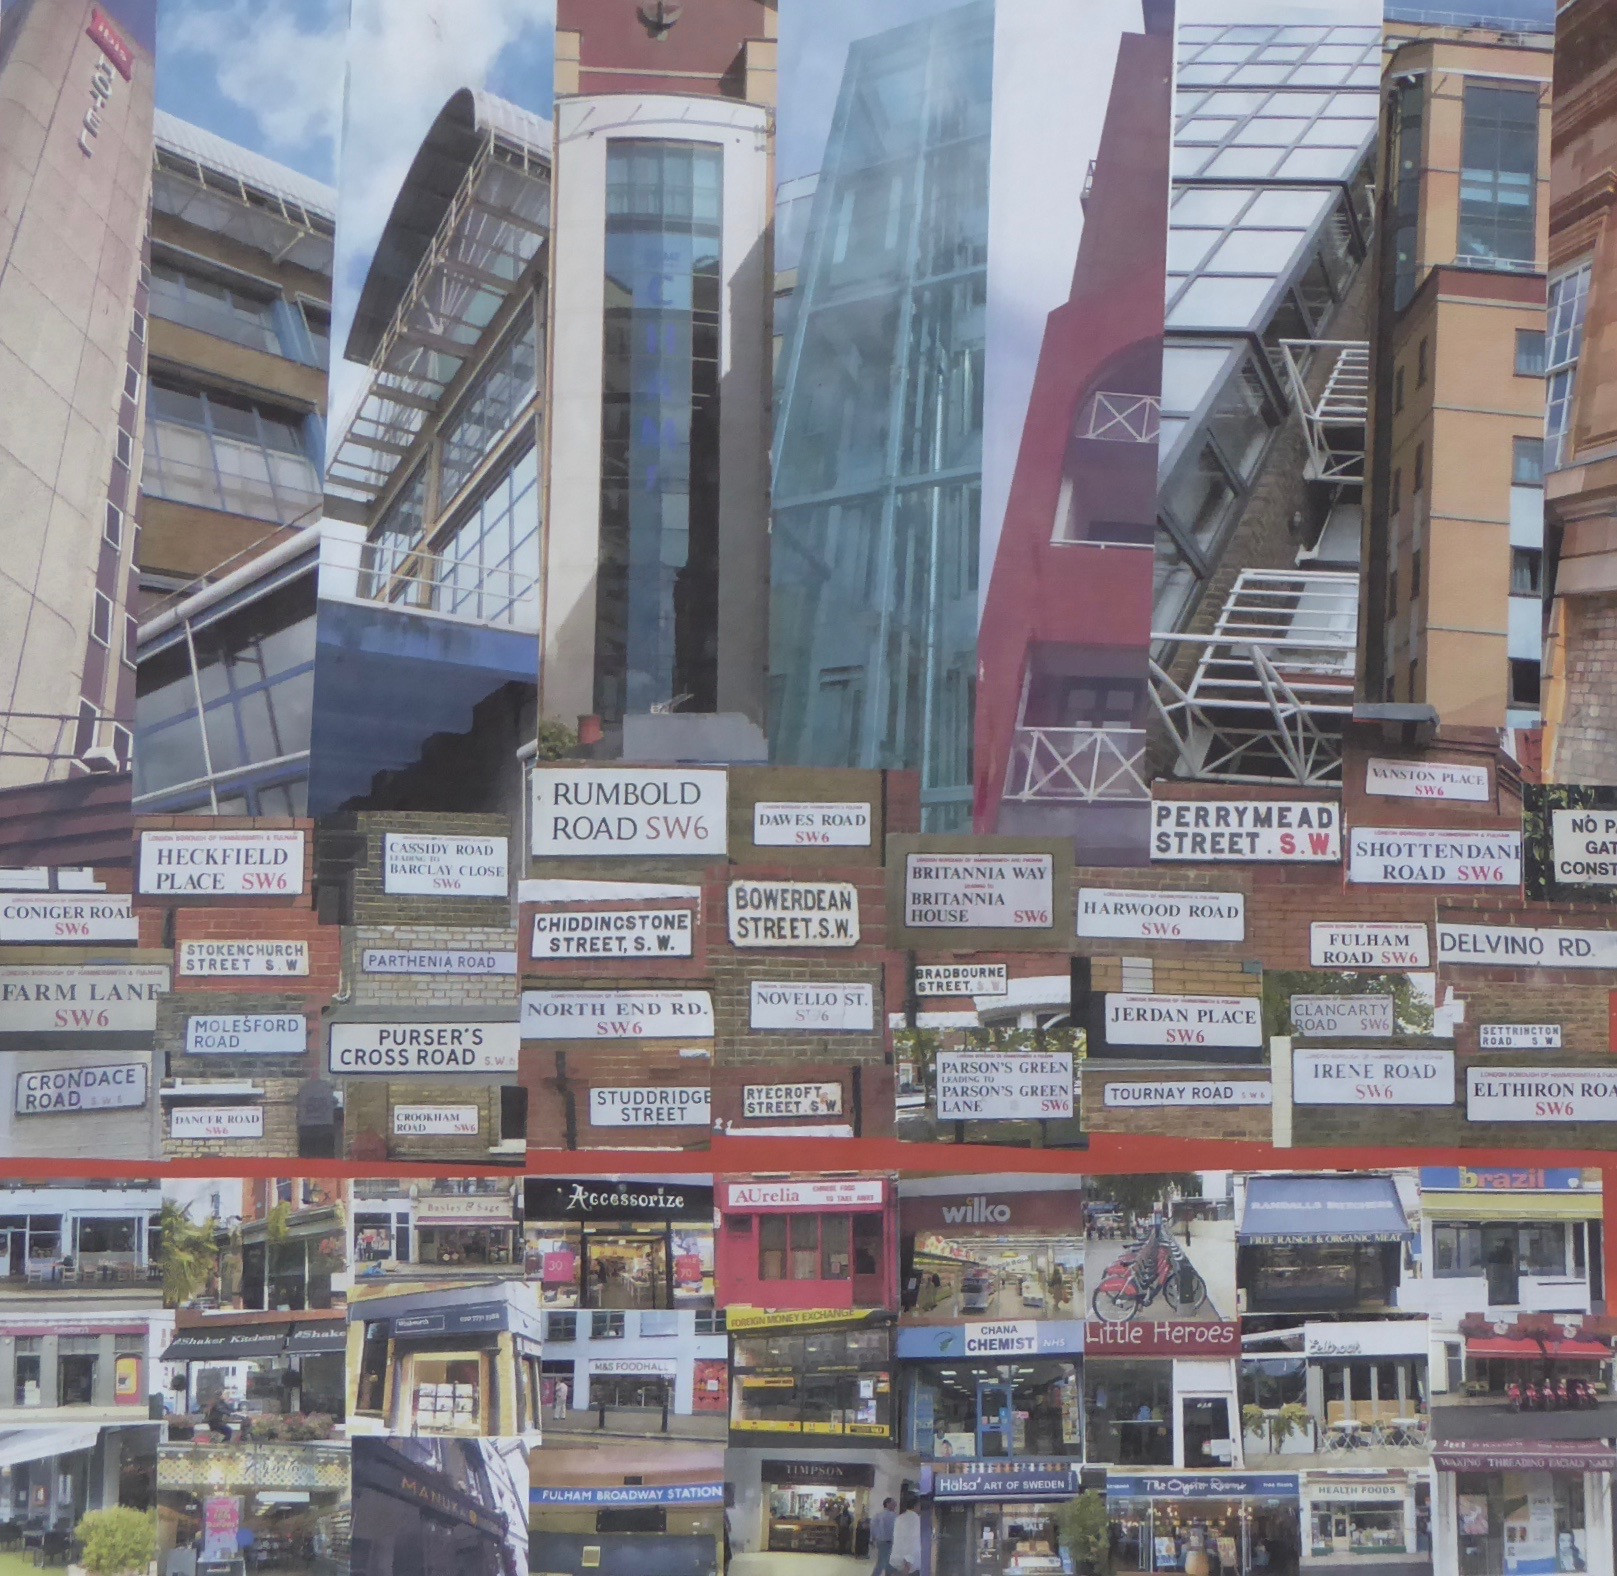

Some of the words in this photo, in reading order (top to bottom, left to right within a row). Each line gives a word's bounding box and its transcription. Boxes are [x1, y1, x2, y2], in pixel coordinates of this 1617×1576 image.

[1373, 768, 1435, 781] VANSTON
[1442, 772, 1485, 786] PLACE
[553, 782, 700, 806] RUMBOLD
[1415, 786, 1444, 796] SW6
[760, 814, 814, 826] DAWES
[822, 814, 866, 827] ROAD
[1156, 806, 1333, 828] PERRYMEAD
[552, 816, 638, 840] ROAD
[645, 816, 709, 840] SW6
[1572, 818, 1598, 834] NO
[1605, 819, 1617, 834] P
[795, 831, 830, 844] SW6
[390, 842, 449, 855] CASSIDY
[456, 844, 494, 856] ROAD
[156, 848, 288, 866] HECKFIELD
[390, 864, 452, 876] BARCLAY
[458, 866, 505, 878] CLOSE
[912, 866, 1006, 880] BRITANNIA
[1012, 866, 1047, 880] WAY
[1383, 864, 1446, 881] ROAD
[1458, 866, 1504, 882] SW6
[156, 872, 226, 890] PLACE
[242, 872, 288, 890] SW6
[432, 878, 461, 889] SW6
[736, 886, 852, 912] BOWERDEAN
[911, 892, 1006, 906] BRITANNIA
[4, 906, 85, 919] CONIGER
[911, 909, 969, 923] HOUSE
[1014, 910, 1048, 924] SW6
[1084, 902, 1181, 918] HARWOOD
[1189, 904, 1239, 920] ROAD
[55, 922, 90, 936] SW6
[1141, 922, 1182, 936] SW6
[1330, 934, 1410, 947] FULHAM
[1440, 932, 1544, 955] DELVINO
[186, 943, 304, 958] STOKENCHURCH
[186, 958, 251, 972] STREET
[368, 956, 453, 968] PARTHENIA
[458, 956, 496, 968] ROAD
[1323, 952, 1374, 964] ROAD
[1382, 952, 1418, 964] SW6
[916, 967, 1004, 980] BRADBOURNE
[2, 983, 77, 1001] FARM
[757, 992, 838, 1006] NOVELLO
[844, 993, 868, 1006] ST.
[528, 1002, 606, 1017] NORTH
[616, 1002, 662, 1017] END
[671, 1002, 708, 1017] RD.
[796, 1008, 830, 1022] S6
[1112, 1006, 1188, 1023] JERDAN
[1198, 1008, 1257, 1024] PLACE
[1294, 1004, 1390, 1016] CLANCARTY
[54, 1008, 110, 1028] SW6
[1295, 1018, 1338, 1030] ROAD
[1360, 1018, 1390, 1030] SW6
[194, 1018, 298, 1034] MOLESFORD
[596, 1020, 643, 1036] SW6
[194, 1035, 240, 1048] ROAD
[379, 1028, 484, 1046] PURSER'S
[1166, 1028, 1205, 1044] SW6
[340, 1048, 410, 1066] CROSS
[416, 1048, 476, 1066] ROAD
[941, 1061, 1014, 1074] PARSON'S
[1018, 1062, 1069, 1074] GREEN
[1314, 1064, 1374, 1080] IRENE
[1384, 1063, 1437, 1080] ROAD
[26, 1068, 136, 1091] CRONDACE
[942, 1075, 980, 1084] LEADING
[984, 1075, 995, 1084] TO
[746, 1086, 822, 1100] RYECROFT
[942, 1084, 1014, 1098] PARSON'S
[1018, 1084, 1070, 1097] GREEN
[1110, 1087, 1185, 1100] TOURNAY
[1192, 1086, 1234, 1100] ROAD
[1355, 1084, 1393, 1100] SW6
[1474, 1082, 1574, 1098] ELTHIRON
[25, 1090, 80, 1110] ROAD
[597, 1090, 711, 1105] STUDDRIDGE
[942, 1100, 983, 1113] LANE
[1041, 1100, 1070, 1112] SW6
[1536, 1102, 1574, 1116] SW6
[176, 1115, 222, 1125] DANCER
[228, 1114, 260, 1124] ROAD
[396, 1113, 460, 1122] CROOKHAM
[622, 1107, 688, 1122] STREET
[206, 1126, 229, 1134] SW6
[396, 1123, 426, 1132] ROAD
[454, 1124, 476, 1132] SW6
[1460, 1166, 1546, 1190] brazil
[566, 1184, 685, 1212] Accessorize
[942, 1196, 1011, 1225] wilko
[1278, 1235, 1313, 1244] RANGE
[1316, 1235, 1324, 1244] &
[730, 1313, 766, 1328] FOREIGN
[768, 1311, 801, 1326] MONEY
[802, 1308, 854, 1322] EXCHANGE
[981, 1326, 1018, 1336] CHANA
[1086, 1321, 1142, 1344] Little
[1154, 1321, 1234, 1344] Heroes
[966, 1336, 1036, 1352] CHEMIST
[1043, 1338, 1066, 1347] NHS
[594, 1362, 614, 1372] M&S
[615, 1361, 669, 1372] FOODHALL
[983, 1481, 1002, 1490] ART
[1006, 1480, 1020, 1490] OF
[1022, 1480, 1065, 1490] SWEDEN
[1318, 1486, 1358, 1495] HEALTH
[1360, 1486, 1396, 1494] FOODS
[542, 1490, 592, 1501] FULHAM
[596, 1488, 664, 1501] BROADWAY
[668, 1486, 722, 1500] STATION
